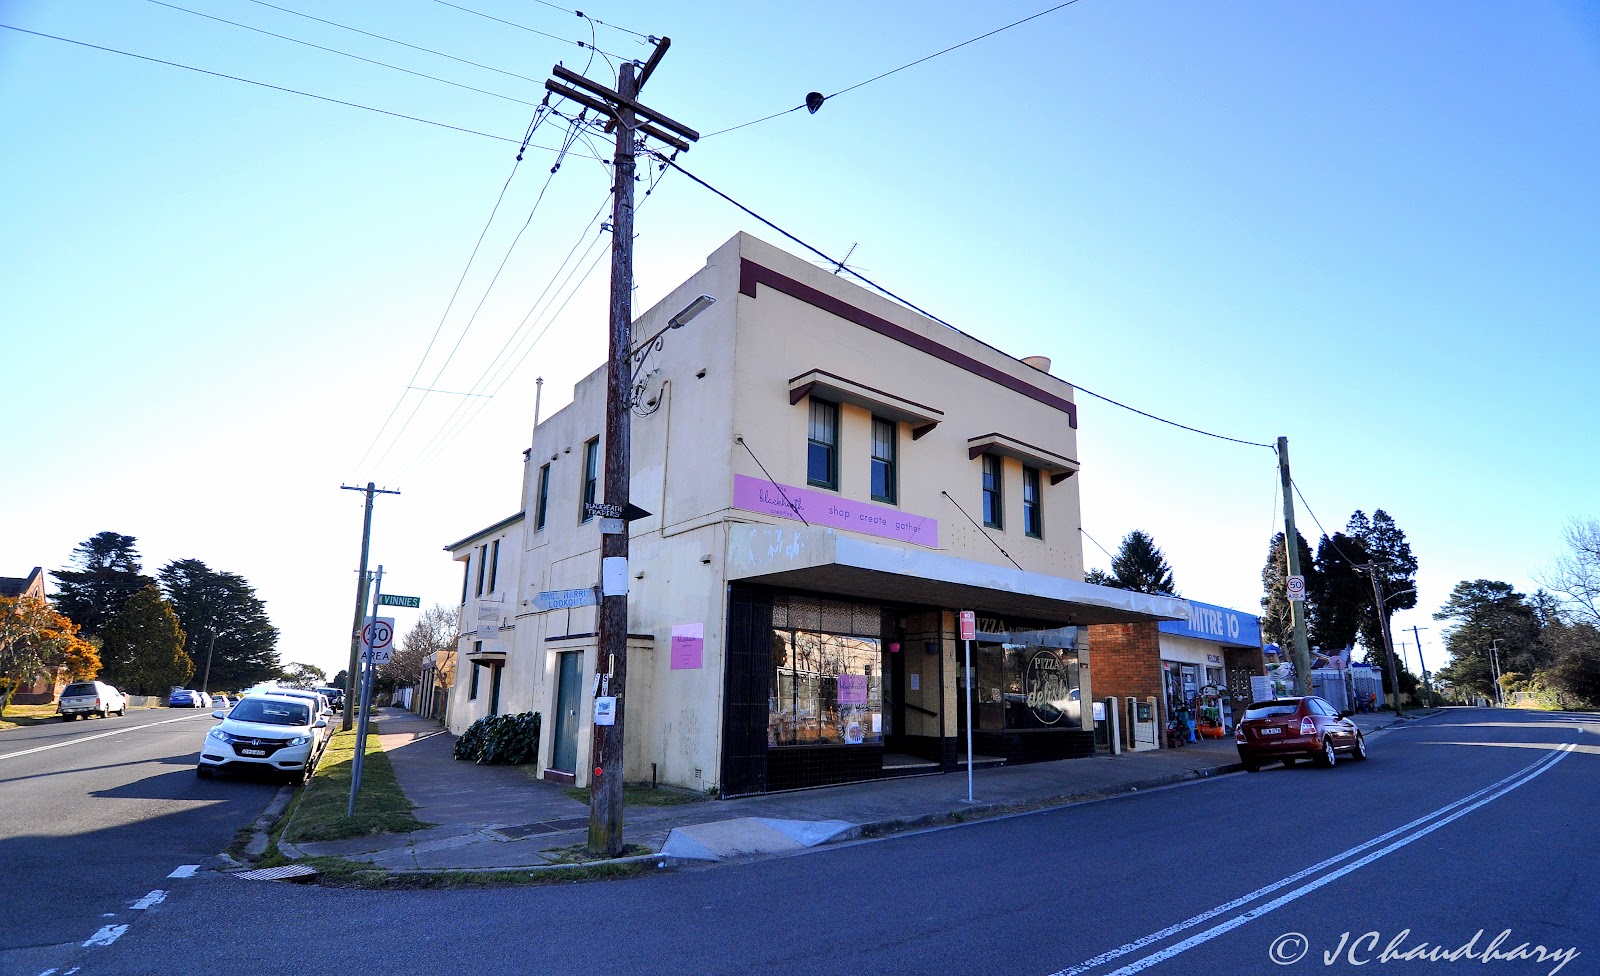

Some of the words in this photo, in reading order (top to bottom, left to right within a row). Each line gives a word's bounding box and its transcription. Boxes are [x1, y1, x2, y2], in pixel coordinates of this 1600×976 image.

[829, 505, 850, 520] shop
[859, 514, 887, 526] create
[895, 521, 921, 533] gather
[384, 595, 418, 607] VINNIES
[976, 618, 1007, 635] IZZA
[1188, 606, 1223, 635] MITRE
[1226, 613, 1240, 639] 10
[361, 652, 389, 660] AREA
[1035, 658, 1060, 669] PIZZA
